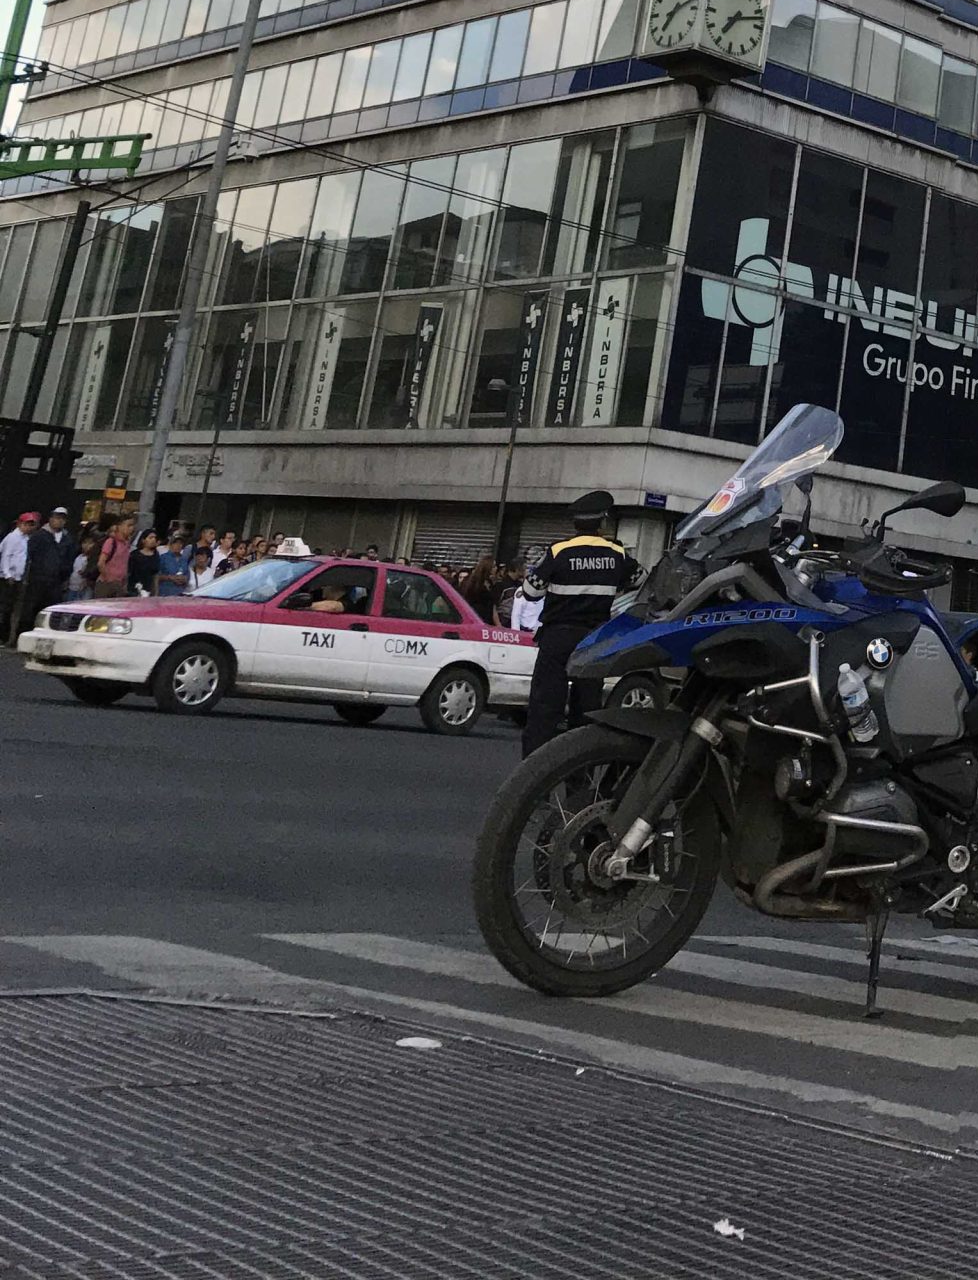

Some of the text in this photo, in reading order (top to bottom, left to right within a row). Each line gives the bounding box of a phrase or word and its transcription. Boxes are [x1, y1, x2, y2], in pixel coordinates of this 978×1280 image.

[226, 347, 246, 423] INBURSA
[553, 332, 574, 424] INBURSA
[592, 326, 612, 419] INBURSA
[862, 343, 944, 393] Grupo
[309, 348, 329, 428] INBURSA
[568, 556, 616, 571] TRANSITO
[683, 607, 798, 626] R1200
[301, 631, 336, 649] TAXI
[384, 638, 429, 656] CDMX
[481, 629, 521, 644] B 00634
